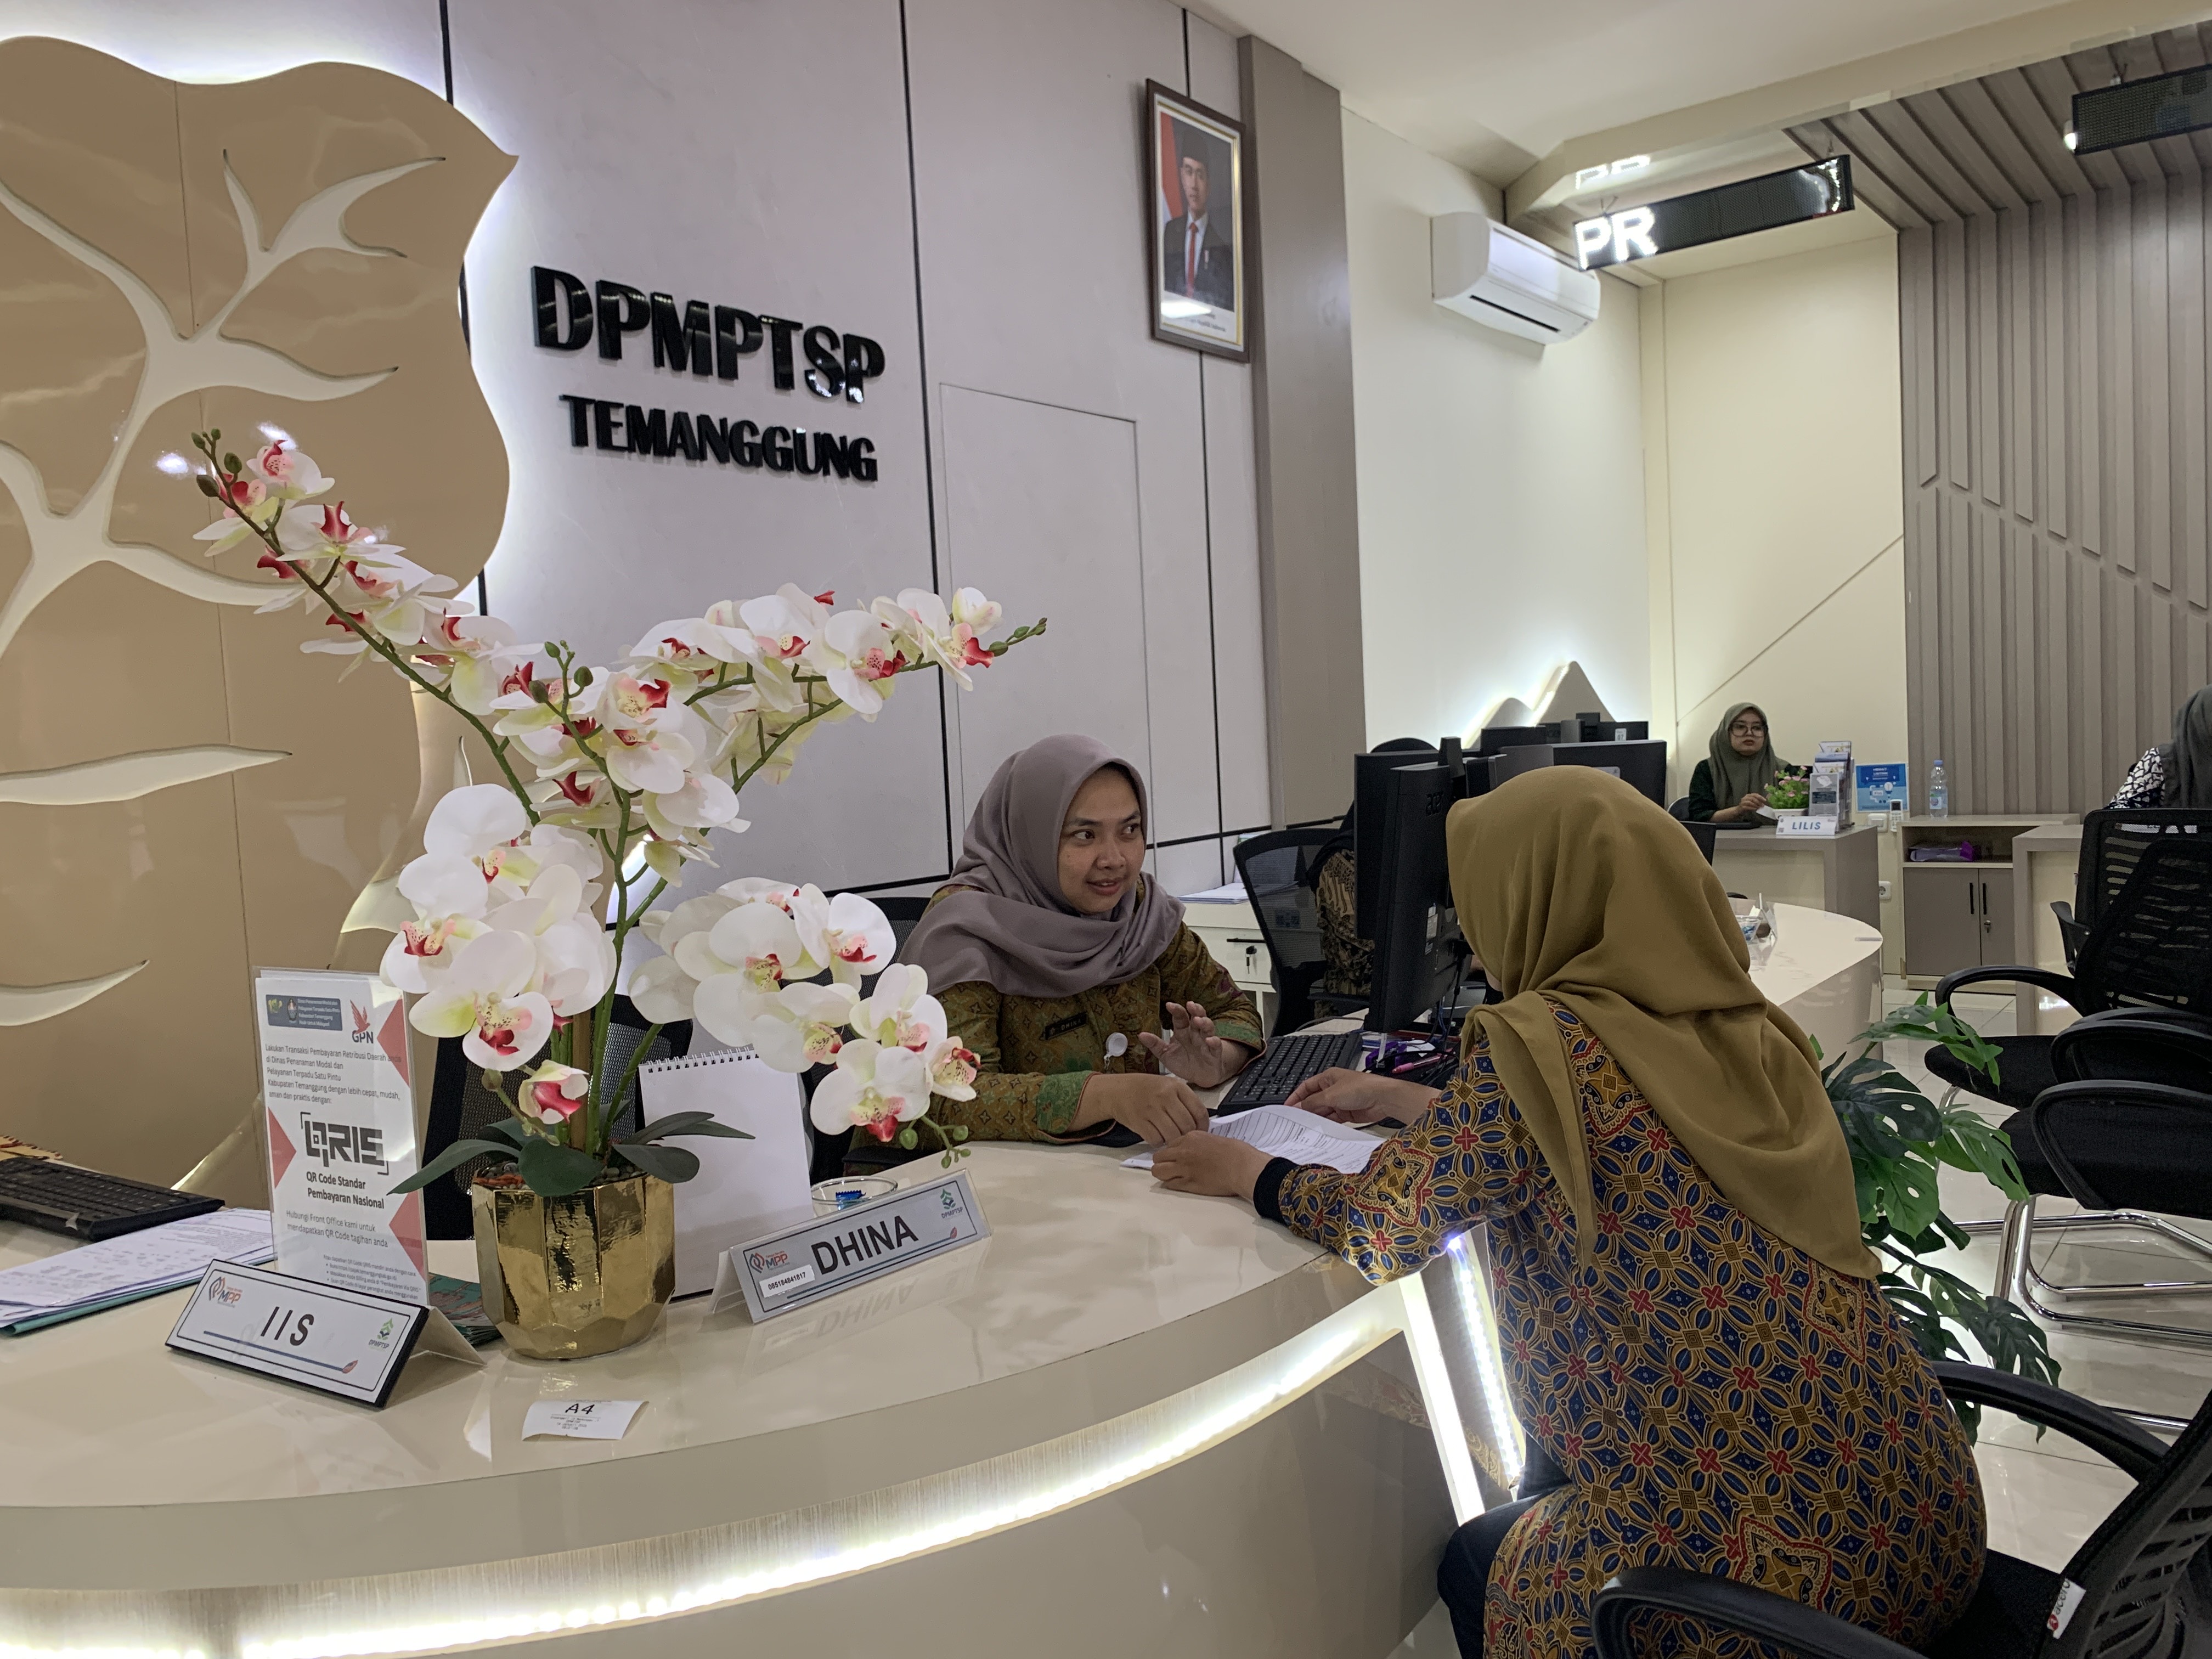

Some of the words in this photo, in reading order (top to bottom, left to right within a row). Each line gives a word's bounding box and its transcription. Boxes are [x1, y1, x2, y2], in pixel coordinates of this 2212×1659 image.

[1575, 206, 1660, 270] PR
[531, 266, 885, 404] DPMPTSP
[558, 394, 878, 482] TEMANGGUNG
[1792, 822, 1821, 830] LILIS
[352, 1030, 374, 1043] GPN
[266, 1044, 284, 1052] Lakukan
[286, 1046, 309, 1054] Transaksi
[311, 1048, 341, 1058] Pembayaran
[343, 1051, 365, 1059] Retribusi
[368, 1053, 386, 1062] Daerah
[287, 1058, 315, 1066] Penanaman
[267, 1068, 292, 1077] Pelayanan
[294, 1069, 313, 1079] Terpadu
[268, 1079, 294, 1089] Kabupaten
[295, 1081, 327, 1093] Temanggung
[329, 1086, 347, 1094] dengan
[362, 1088, 379, 1098] cepat,
[380, 1091, 400, 1101] mudah,
[294, 1094, 310, 1102] praktis
[304, 1120, 385, 1167] QRIS
[306, 1171, 317, 1182] QR
[318, 1173, 336, 1186] Code
[338, 1176, 366, 1189] Standar
[308, 1187, 351, 1204] Pembayaran
[353, 1194, 385, 1209] Nasional
[286, 1210, 309, 1222] Hubungi
[310, 1214, 325, 1223] Front
[326, 1217, 343, 1227] Office
[345, 1220, 357, 1229] kami
[359, 1223, 376, 1232] untuk
[941, 1207, 963, 1218] DPMPTSP
[287, 1223, 324, 1236] mendapatkan
[325, 1229, 334, 1238] QR
[335, 1231, 349, 1240] Code
[351, 1234, 372, 1245] tagihan
[374, 1239, 388, 1248] anda
[811, 1215, 919, 1274] DHINA
[765, 1254, 788, 1268] MPP
[768, 1272, 805, 1290] 085184841817
[218, 1290, 241, 1304] MPP
[260, 1306, 314, 1346] IIS
[368, 1339, 390, 1348] DPMPTSP
